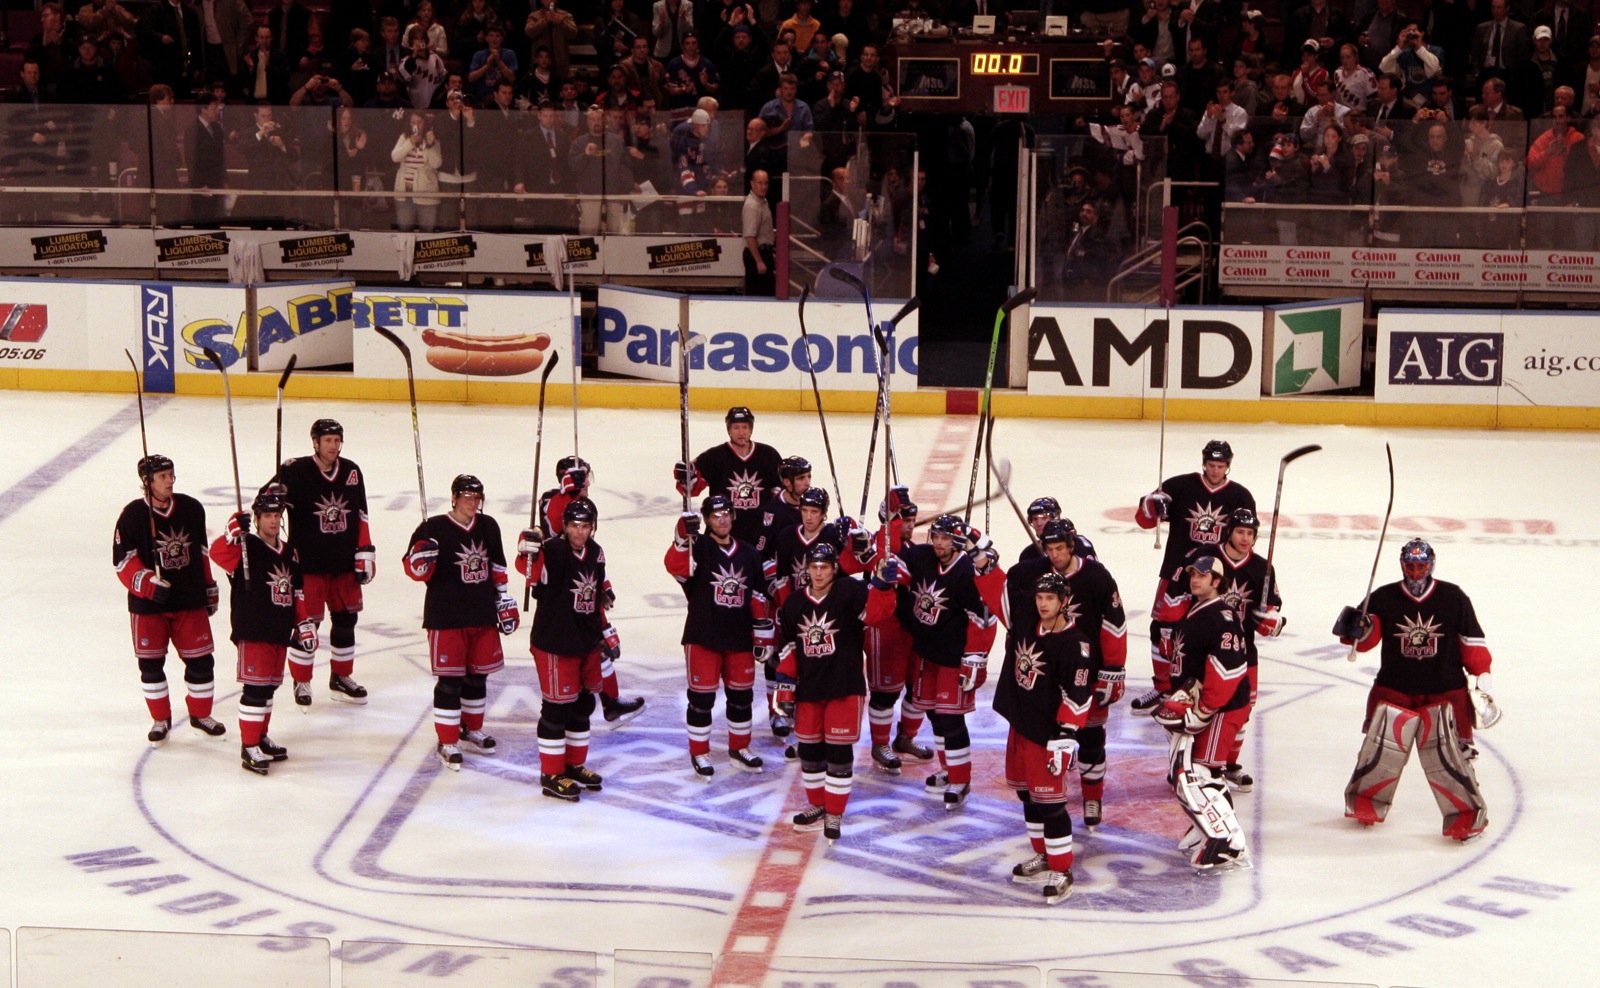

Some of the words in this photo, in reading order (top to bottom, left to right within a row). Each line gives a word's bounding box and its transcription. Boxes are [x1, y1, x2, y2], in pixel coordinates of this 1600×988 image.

[973, 54, 1022, 74] 00.0
[998, 90, 1027, 111] EXIT
[50, 233, 88, 245] LUMBER
[173, 235, 213, 246] LUMBER
[297, 236, 336, 248] LUMBER
[420, 239, 458, 250] LUMBER
[665, 242, 703, 254] LUMBER
[1223, 248, 1268, 258] Canon
[1287, 249, 1330, 260] Canon
[1352, 250, 1397, 261] Canon
[1416, 251, 1461, 262] Canon
[1482, 252, 1528, 263] Canon
[1548, 254, 1594, 265] Canon
[47, 255, 98, 266] 1-800-FLOORING
[171, 256, 221, 267] 1-800-FLOORING
[294, 258, 345, 268] 1-800-FLOORING
[417, 260, 467, 270] 1-800-FLOORING
[662, 263, 711, 274] 1-800-FLOORING
[1222, 266, 1267, 276] Canon
[1286, 267, 1330, 278] Canon
[1351, 268, 1396, 279] Canon
[1415, 269, 1460, 280] Canon
[1481, 270, 1527, 281] Canon
[1547, 272, 1593, 283] Canon
[181, 286, 468, 370] SABRETT
[598, 306, 919, 374] Panasonic
[1029, 316, 1252, 389] AMD
[1394, 336, 1497, 381] AIG
[346, 470, 359, 485] A
[806, 643, 833, 655] NYR
[1074, 668, 1089, 686] 51
[65, 845, 480, 977] MADISON
[1173, 875, 1578, 988] GARDEN
